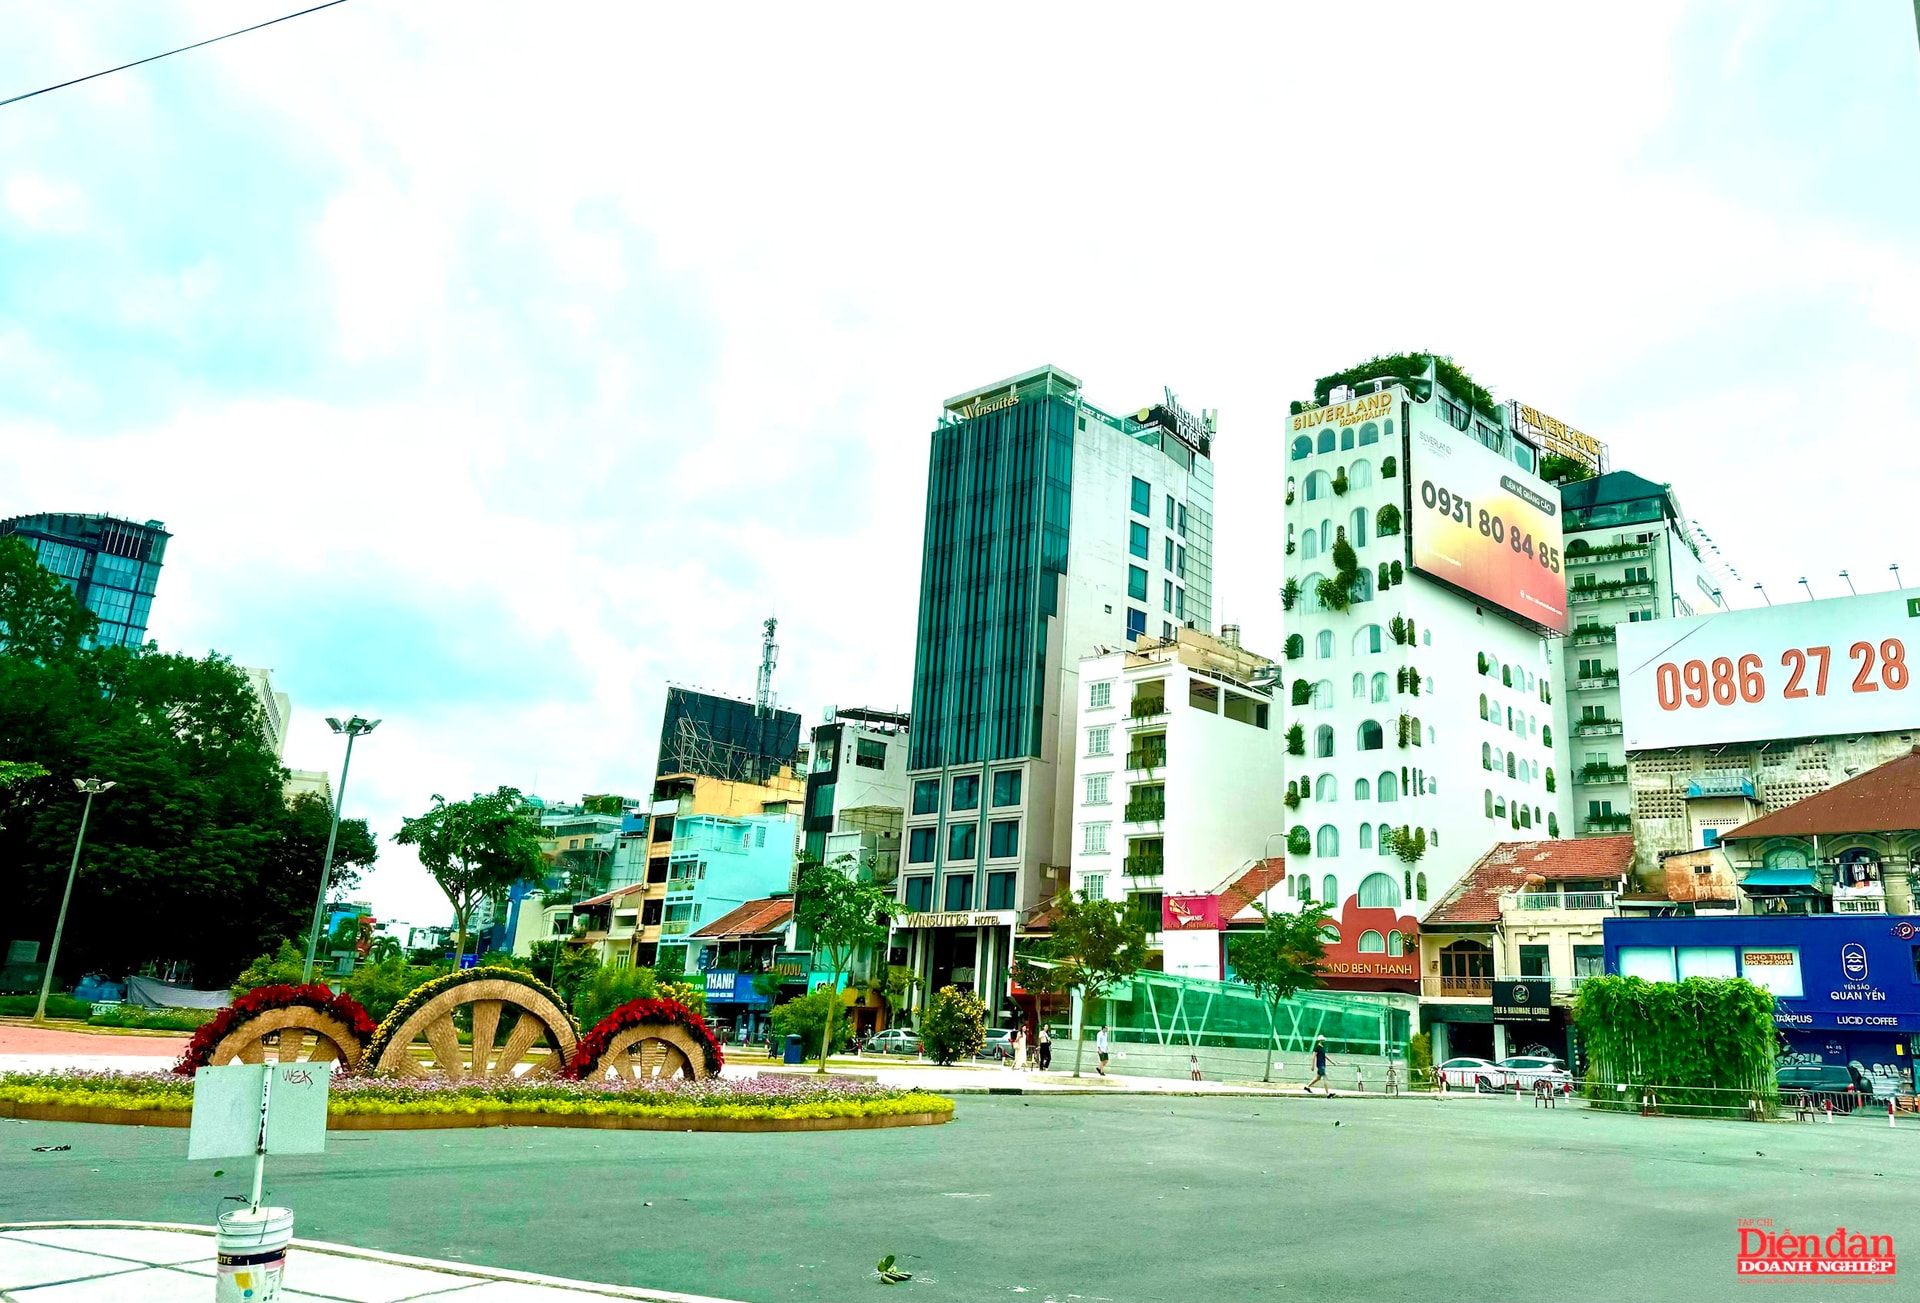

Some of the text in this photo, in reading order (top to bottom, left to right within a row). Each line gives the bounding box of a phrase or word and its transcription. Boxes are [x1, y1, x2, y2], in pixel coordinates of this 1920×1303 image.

[1293, 392, 1392, 430] SILVERLAND
[1339, 406, 1391, 427] HOSPITALITY
[1521, 405, 1600, 455] SILVERLAND
[1421, 479, 1560, 574] 0931 80 84 85
[1656, 638, 1909, 711] 0986 27 28
[906, 912, 1000, 928] WINSUITES HOTEL
[1351, 963, 1372, 974] BEN
[1374, 963, 1413, 975] THANH
[1830, 991, 1862, 1001] QUAN
[1836, 1016, 1864, 1025] LUCID
[1865, 1016, 1898, 1026] COFFEE
